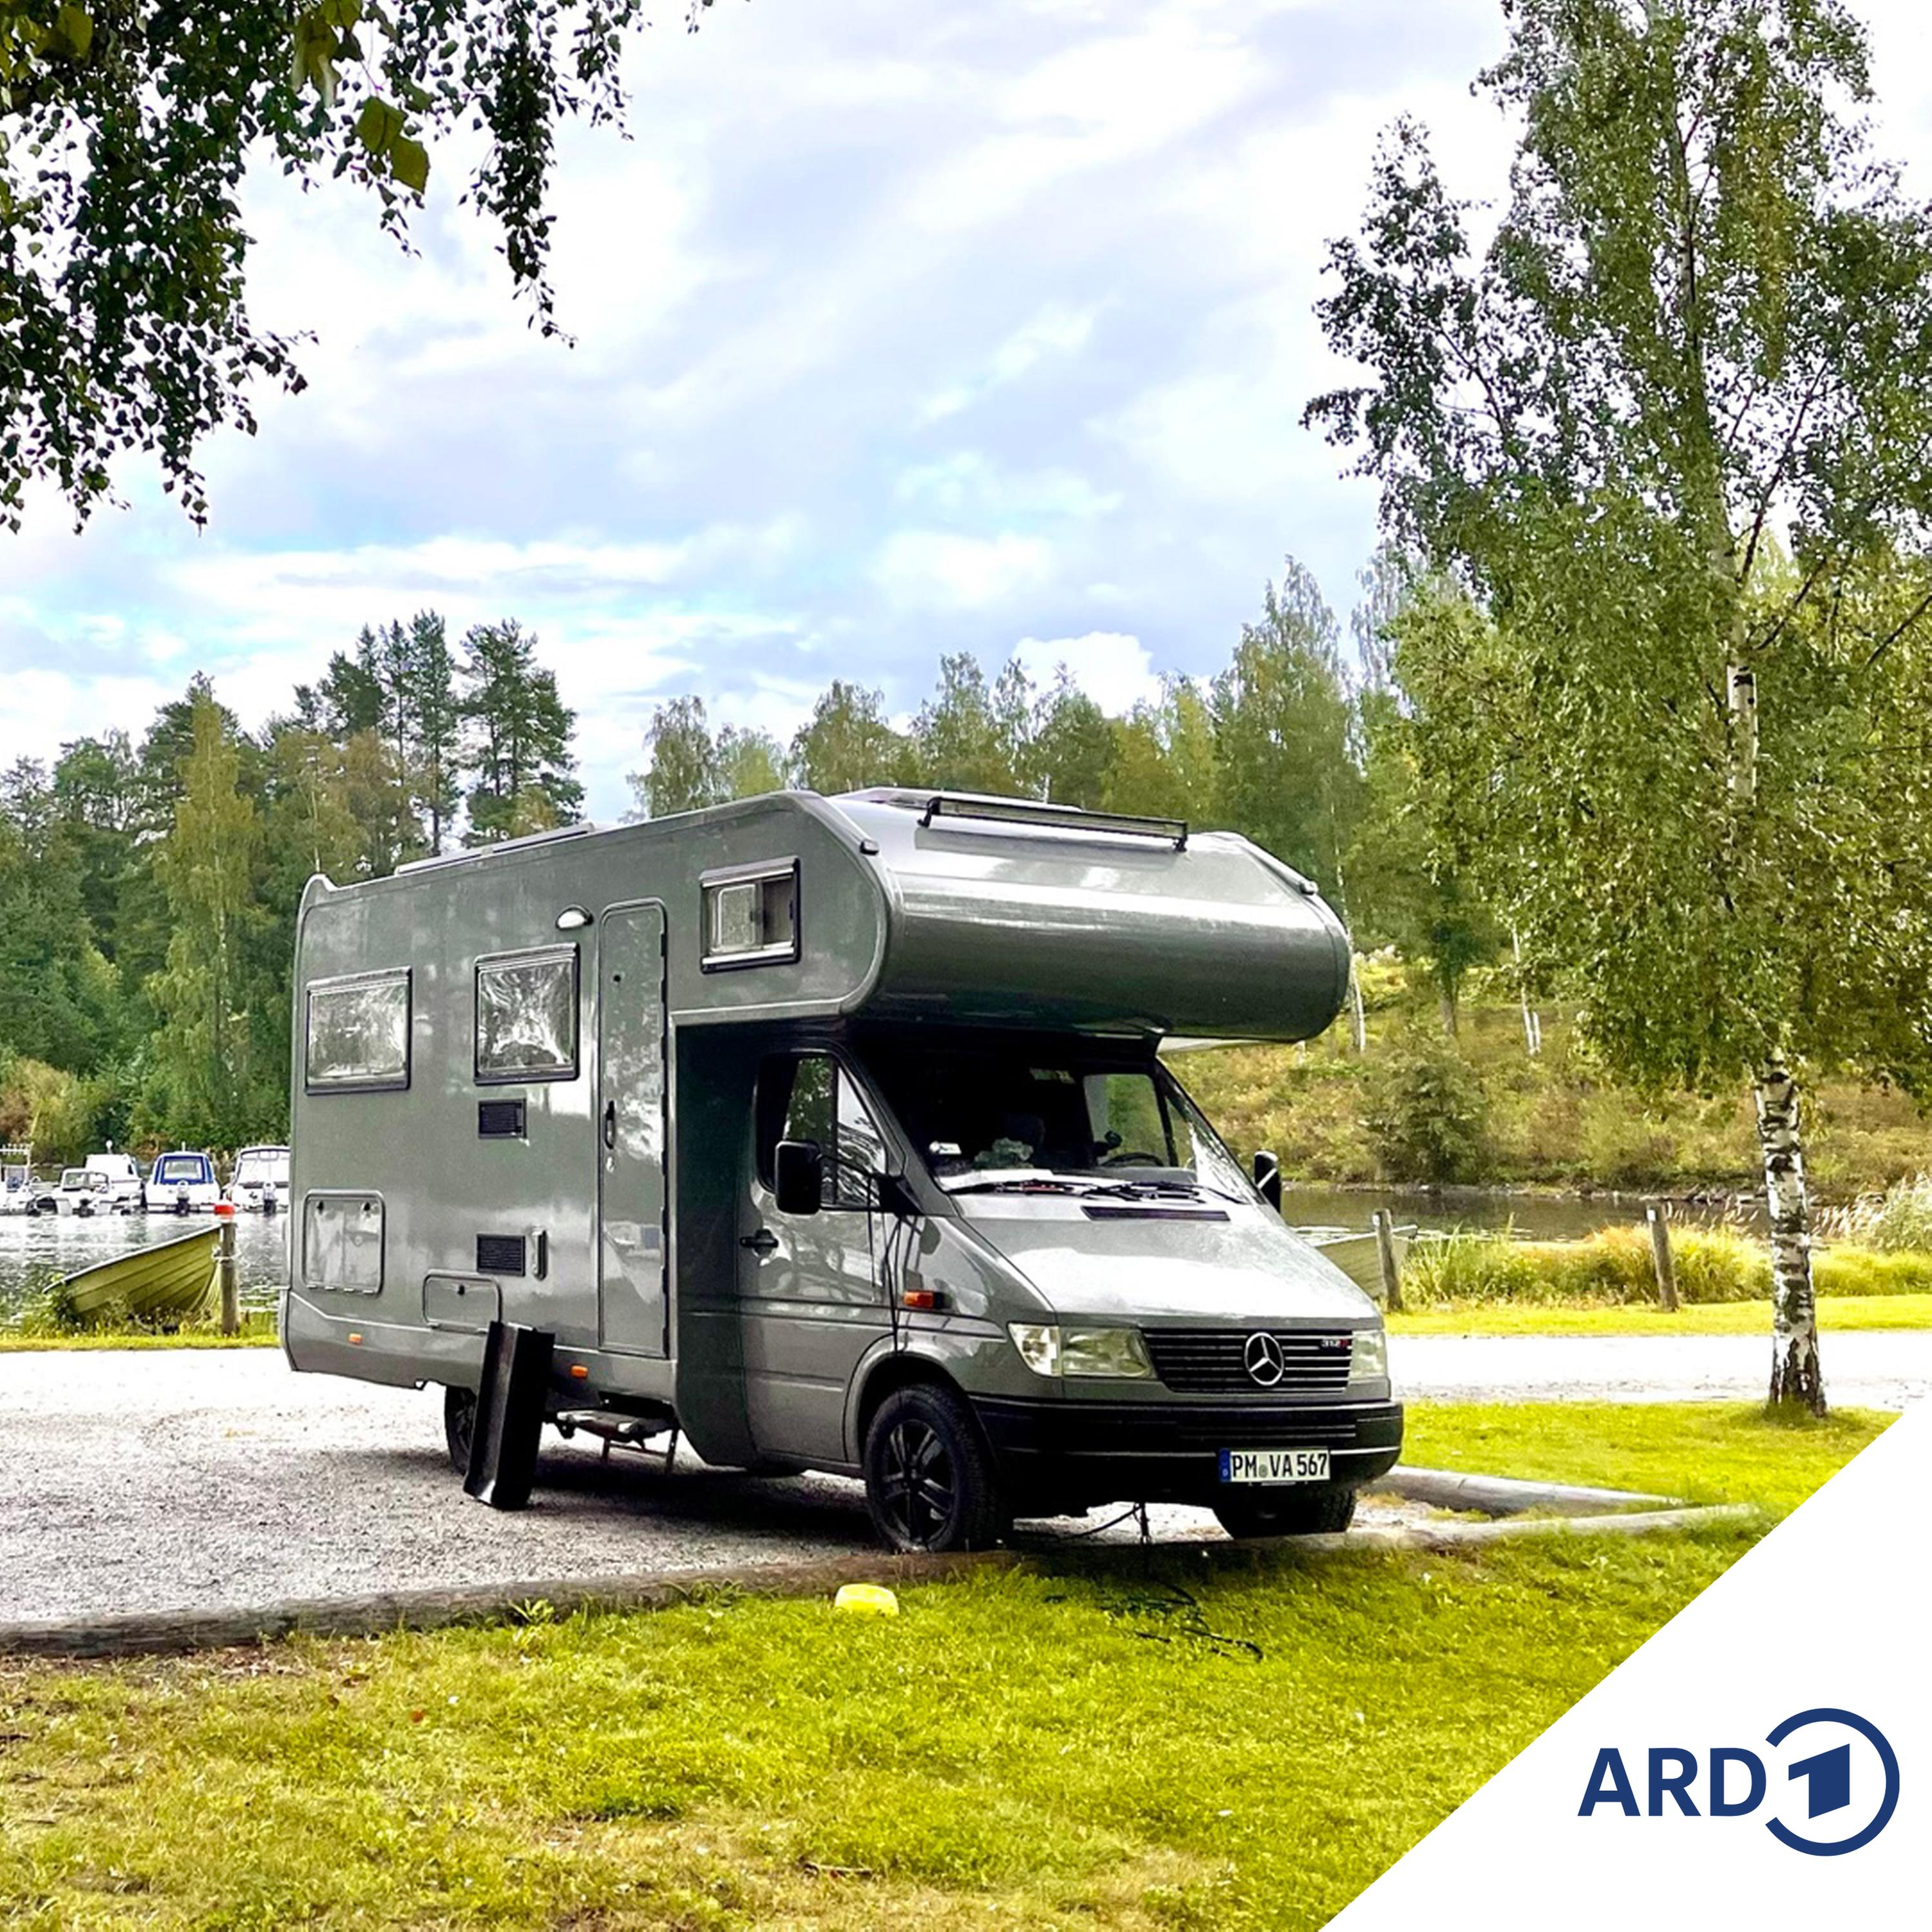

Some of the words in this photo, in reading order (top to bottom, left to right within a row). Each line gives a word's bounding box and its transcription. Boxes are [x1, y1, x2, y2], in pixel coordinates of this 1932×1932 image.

[1233, 1454, 1257, 1478] PM
[1269, 1454, 1293, 1477] VA
[1297, 1453, 1327, 1476] 567
